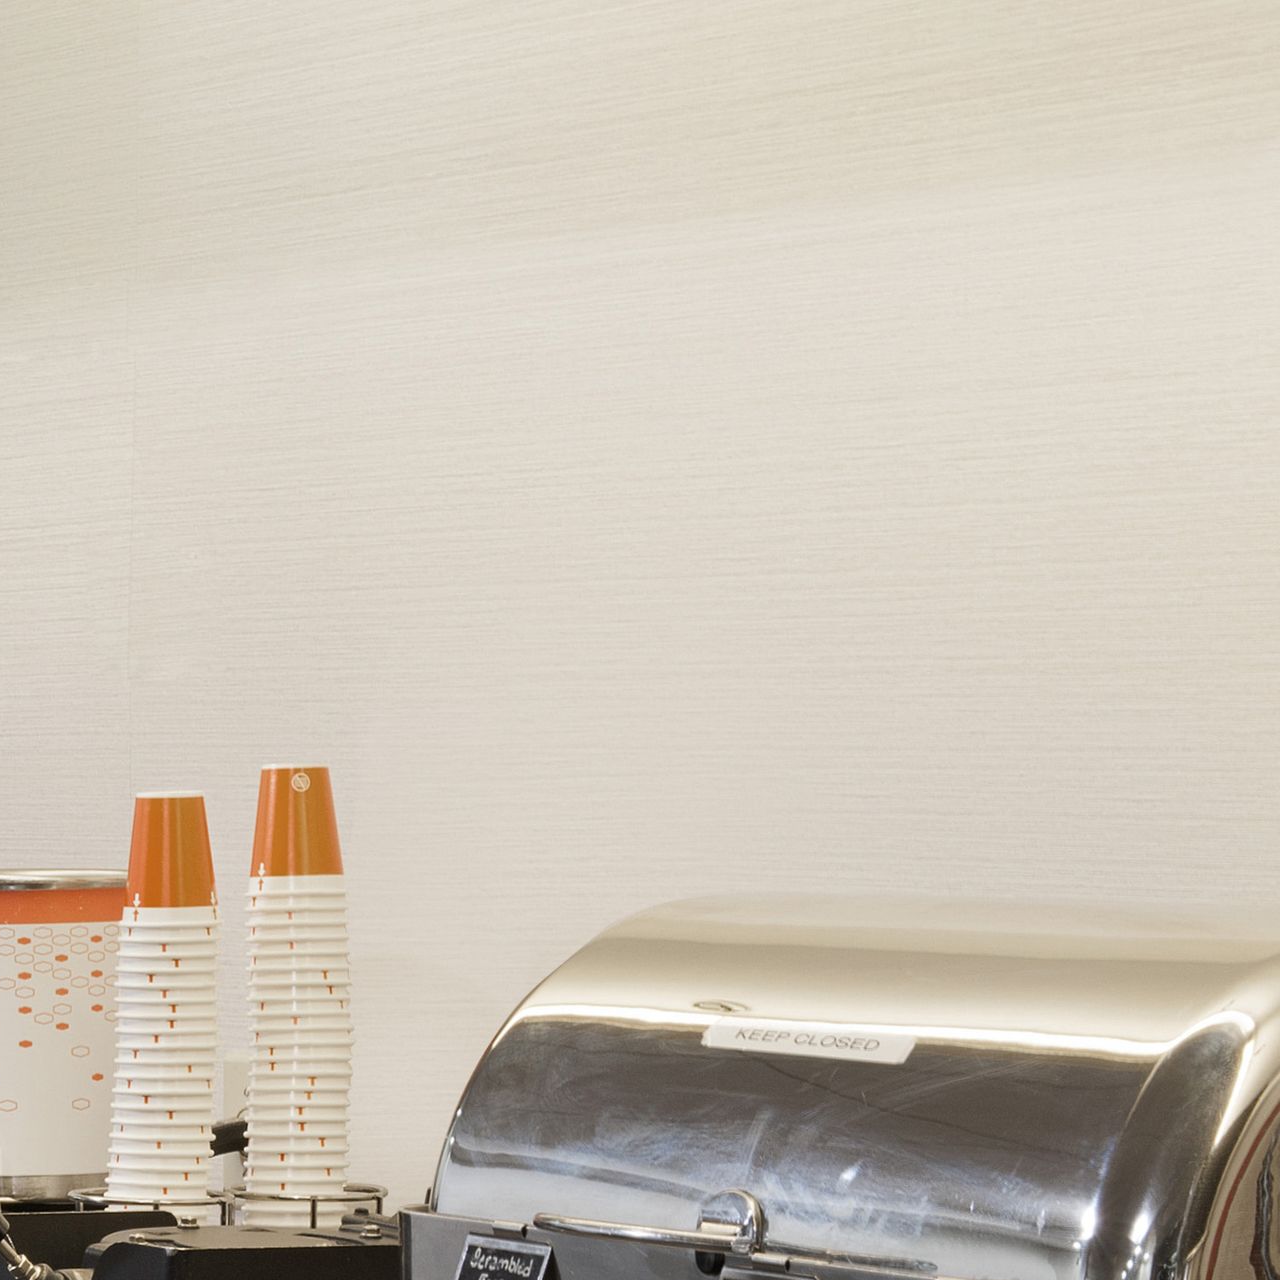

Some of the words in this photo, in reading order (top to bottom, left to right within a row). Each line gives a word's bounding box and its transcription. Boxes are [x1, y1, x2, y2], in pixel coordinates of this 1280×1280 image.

[735, 1028, 791, 1043] KEEP
[794, 1033, 880, 1051] CLOSED
[470, 1248, 533, 1277] Scrambled
